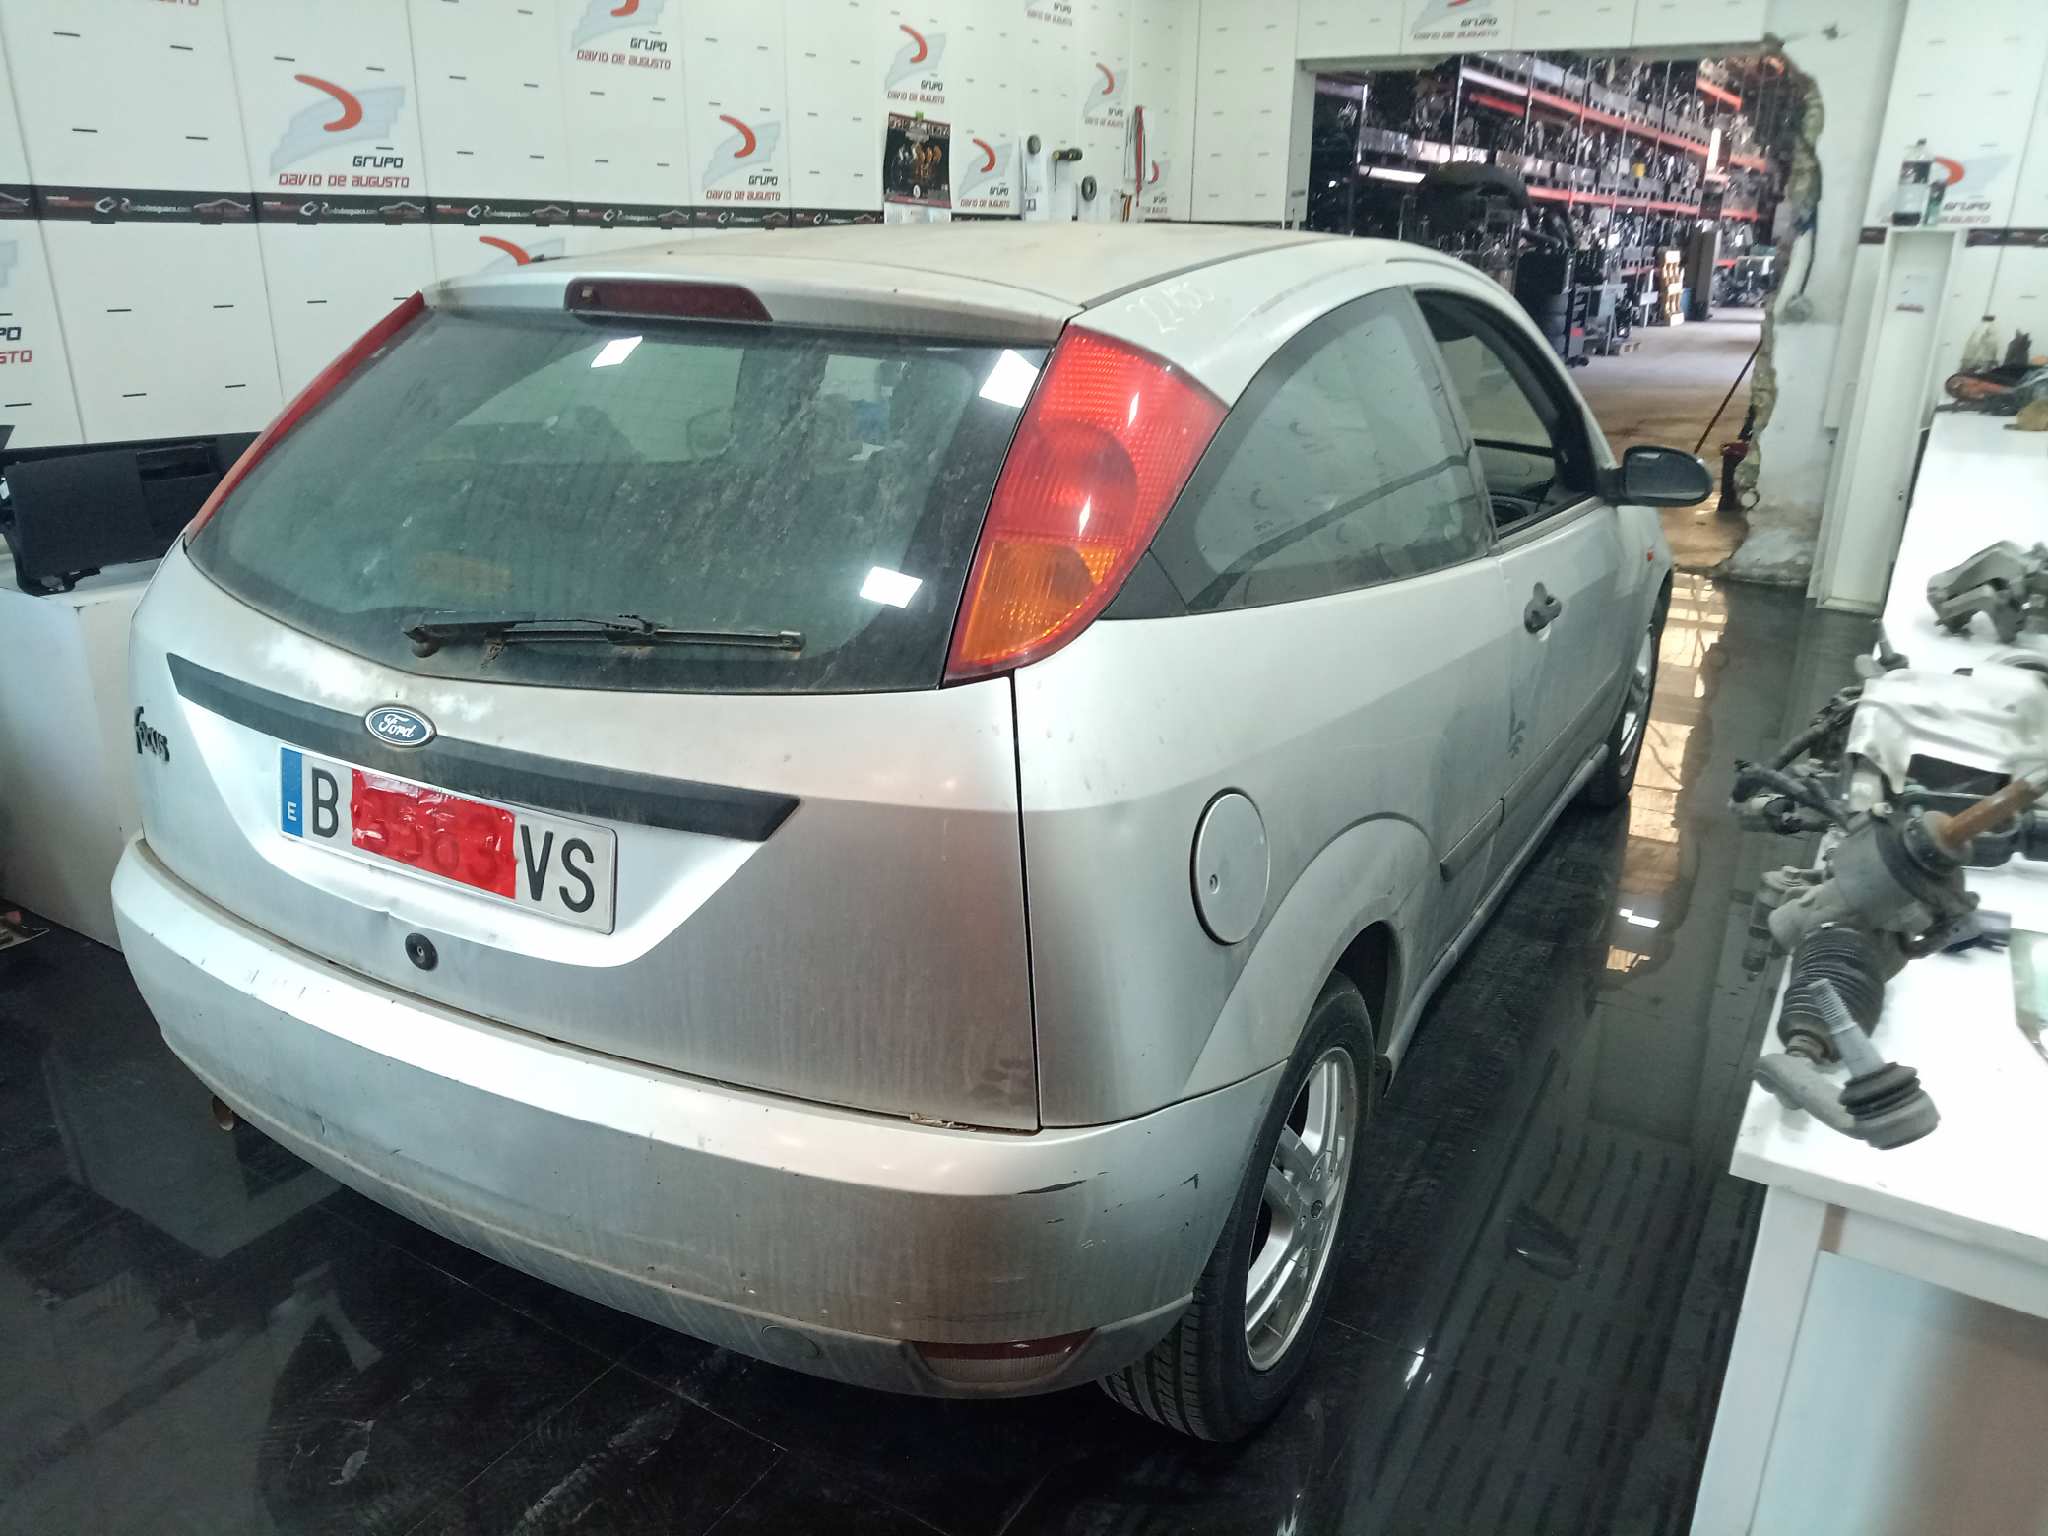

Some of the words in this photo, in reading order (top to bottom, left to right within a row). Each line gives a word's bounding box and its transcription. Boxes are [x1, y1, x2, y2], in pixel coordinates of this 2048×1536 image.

[630, 37, 668, 53] GRUPO
[352, 155, 404, 169] GRUPO
[279, 173, 322, 187] DAVID
[327, 174, 347, 187] DE
[351, 175, 410, 188] AUGUSTO
[748, 175, 778, 187] GRUPO
[378, 713, 417, 738] Ford
[287, 802, 297, 822] E
[311, 766, 339, 838] B
[520, 824, 595, 913] VS
